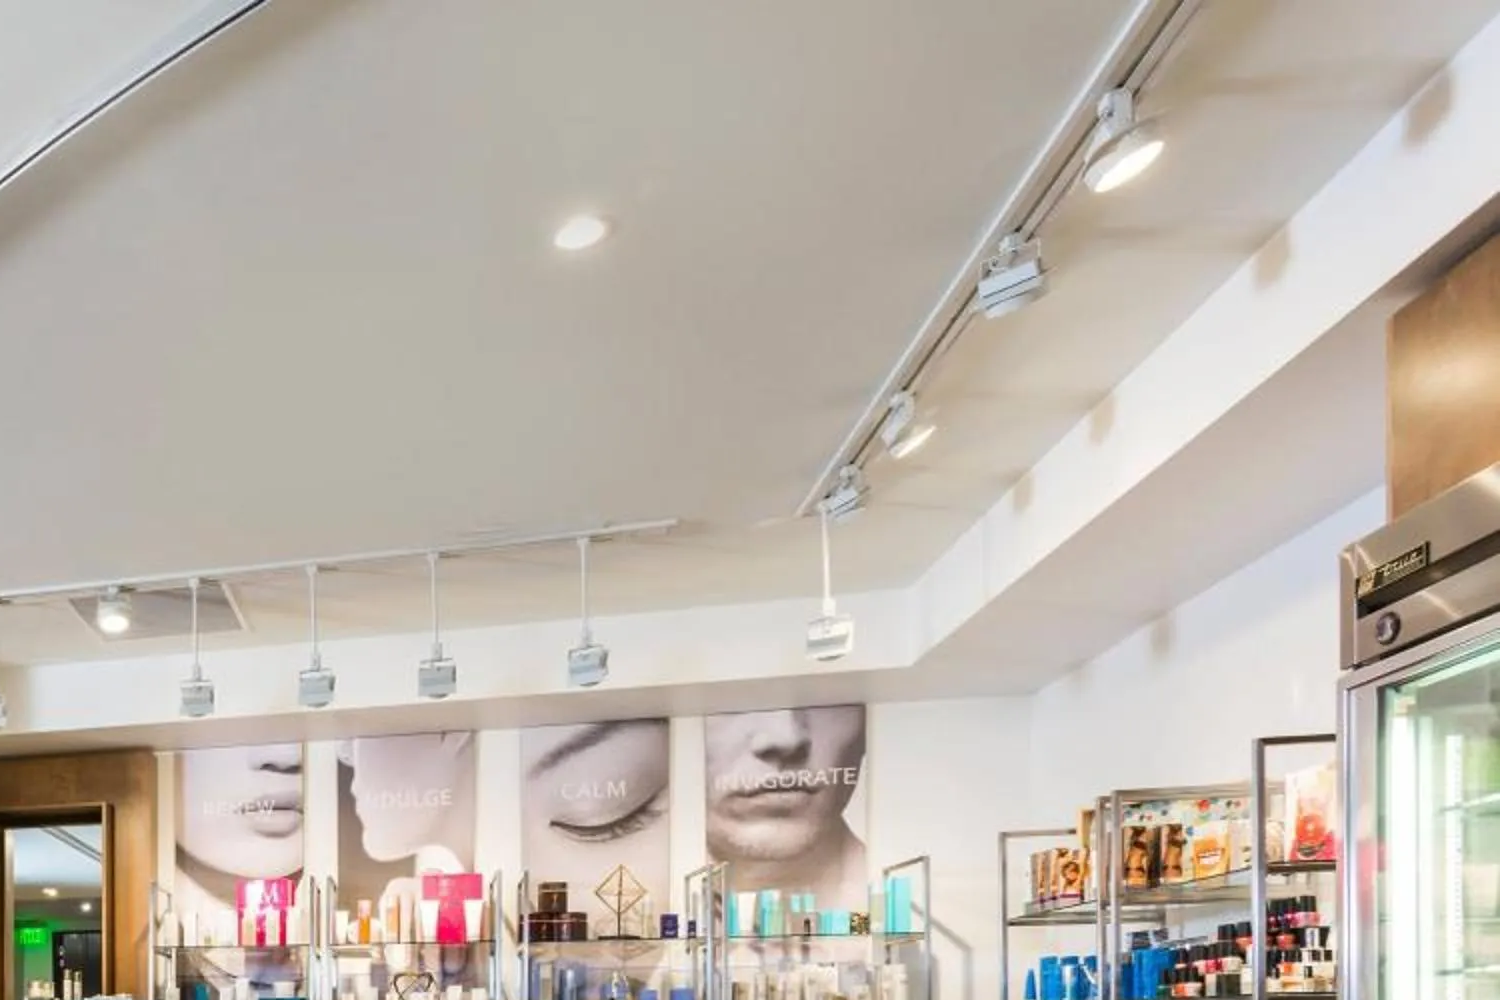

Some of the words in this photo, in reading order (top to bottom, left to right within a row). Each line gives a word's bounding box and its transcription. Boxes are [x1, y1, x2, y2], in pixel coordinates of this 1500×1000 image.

[561, 780, 627, 801] CALM
[714, 767, 857, 791] INVIGORATE
[364, 786, 454, 809] NDULGE
